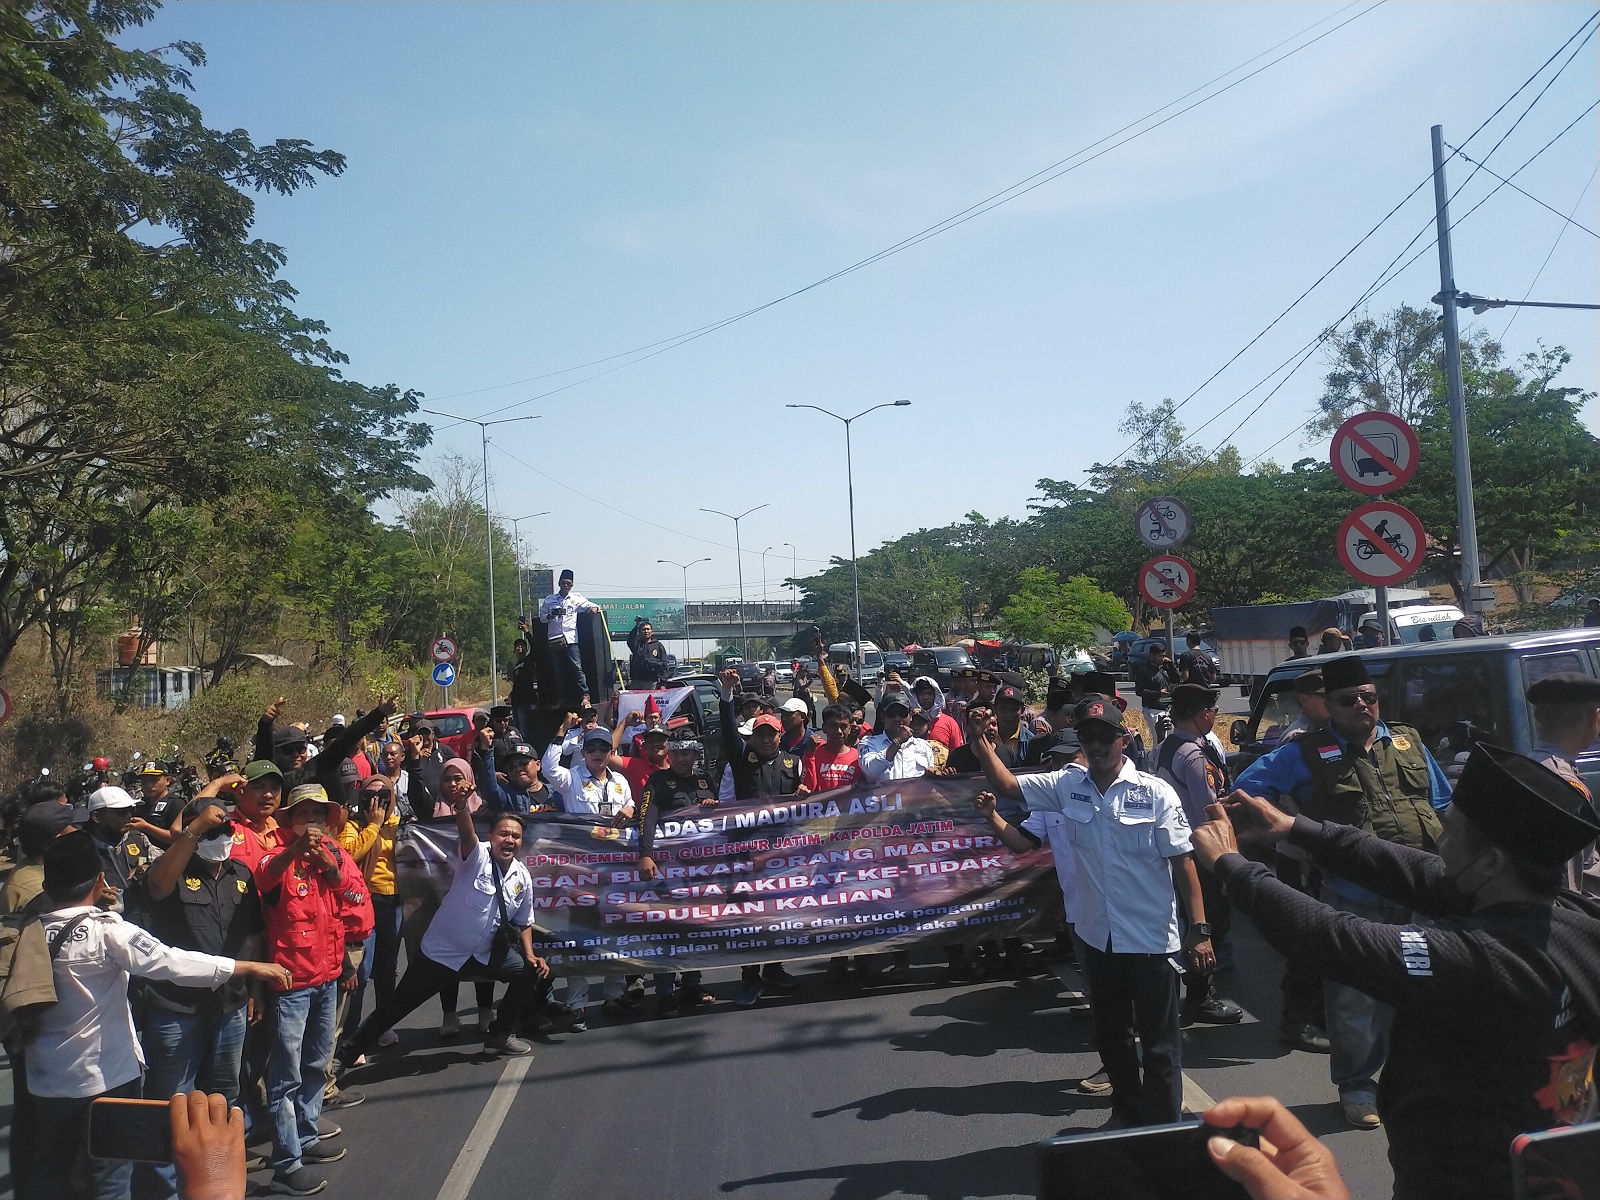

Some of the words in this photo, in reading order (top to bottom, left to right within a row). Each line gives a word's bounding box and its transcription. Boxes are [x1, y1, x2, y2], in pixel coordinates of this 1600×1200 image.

[735, 801, 841, 828] MADURA
[849, 793, 903, 815] ASLI
[526, 854, 570, 867] BPTD
[679, 839, 770, 860] GUBERNUR
[772, 833, 825, 849] JATIM,
[829, 825, 903, 842] KAPOLDA
[906, 820, 954, 835] JATIM
[765, 848, 875, 869] ORANG
[884, 836, 1003, 857] MADUR
[606, 884, 724, 904] SIA-SIA
[732, 871, 848, 894] AKIBAT
[858, 855, 1004, 881] KE-TIDAK
[583, 936, 611, 947] air
[616, 931, 680, 946] garam
[687, 925, 762, 939] campur
[768, 920, 804, 932] olie
[810, 916, 848, 928] dari
[854, 910, 906, 923] truck
[912, 897, 1025, 919] pengangkut
[604, 900, 766, 924] PEDULIAN
[775, 887, 894, 911] KALIAN
[569, 946, 664, 961] membuat
[669, 942, 719, 956] jalan
[725, 939, 768, 949] licin
[775, 935, 810, 945] sbg
[815, 924, 910, 943] penyebab
[915, 920, 958, 931] laka
[963, 912, 1022, 926] lantas
[1400, 931, 1434, 976] NKRI
